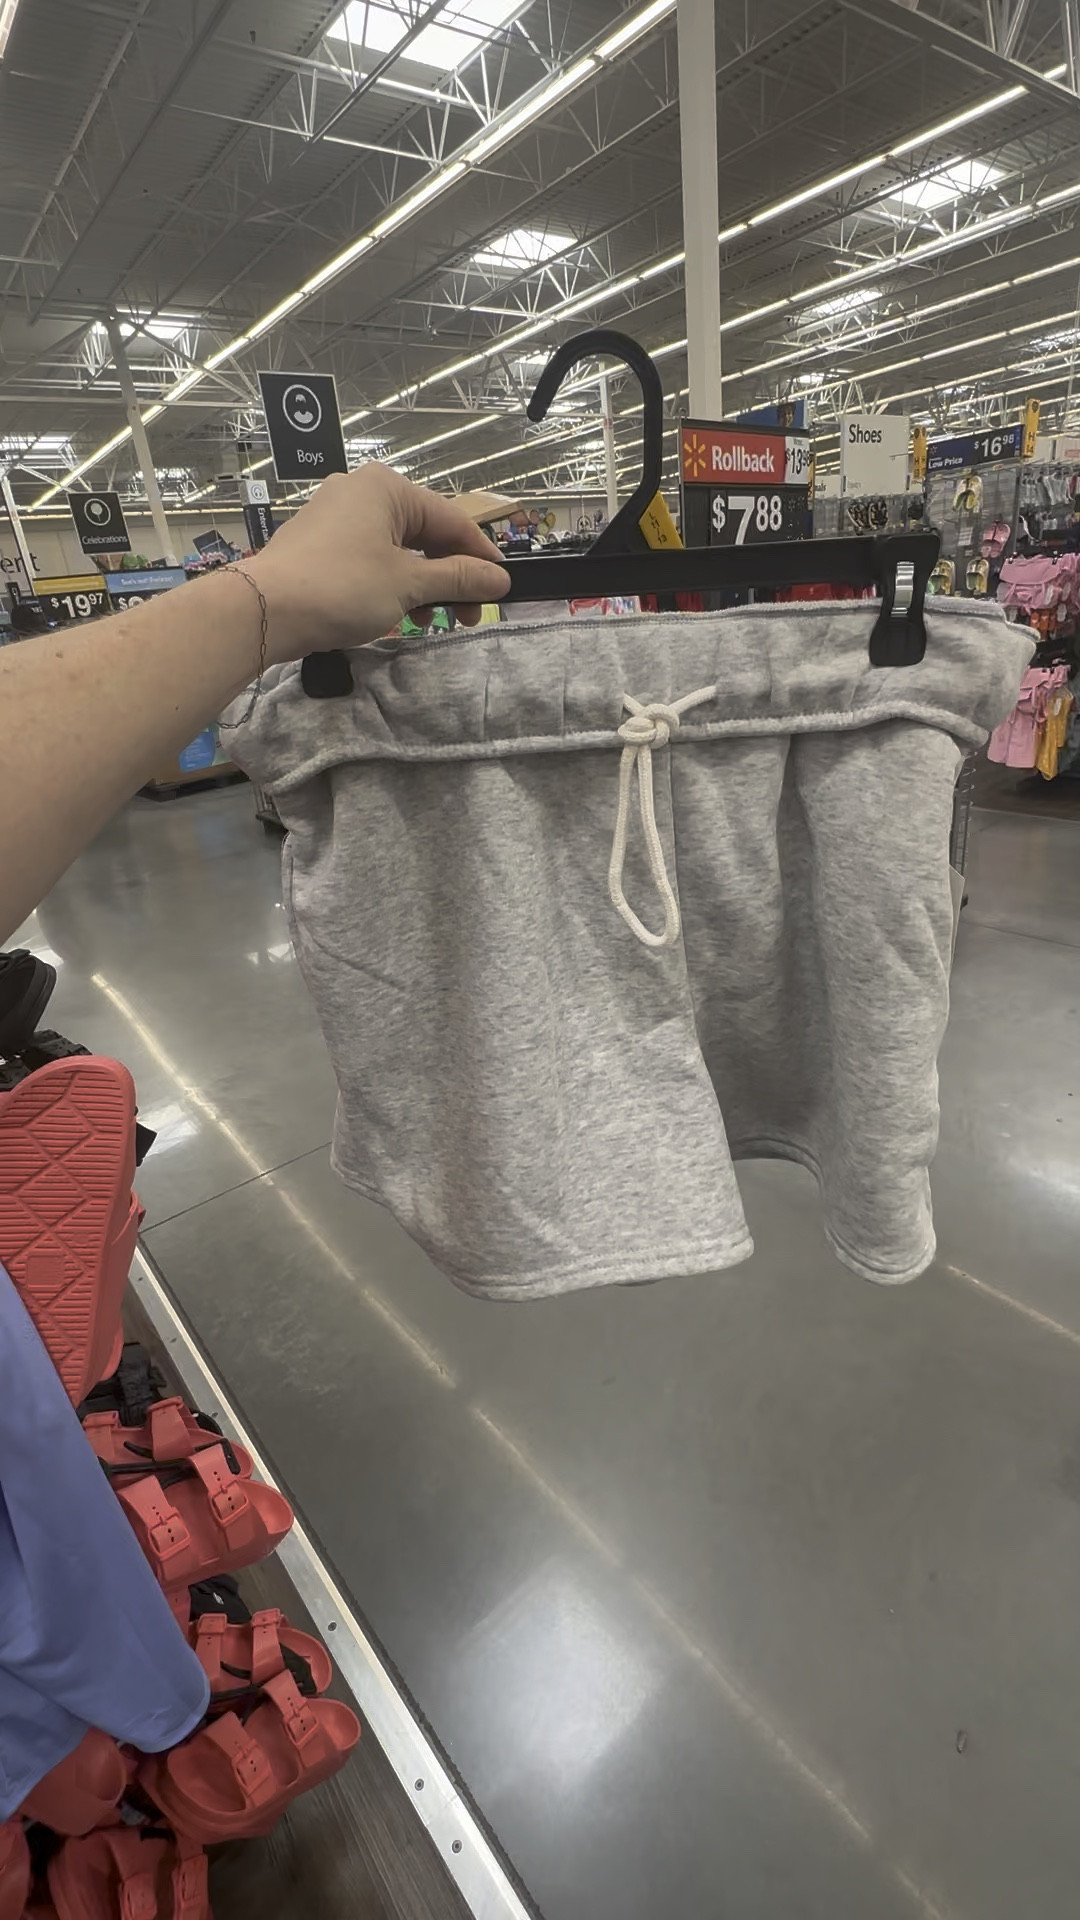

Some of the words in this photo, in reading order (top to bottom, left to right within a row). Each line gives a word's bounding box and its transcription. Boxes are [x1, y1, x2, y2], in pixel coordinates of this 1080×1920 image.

[849, 424, 882, 443] Shoes
[296, 449, 325, 466] Boys
[711, 445, 775, 473] Rollback
[928, 459, 943, 469] Low
[944, 456, 964, 466] Price
[82, 535, 128, 545] Celebrations
